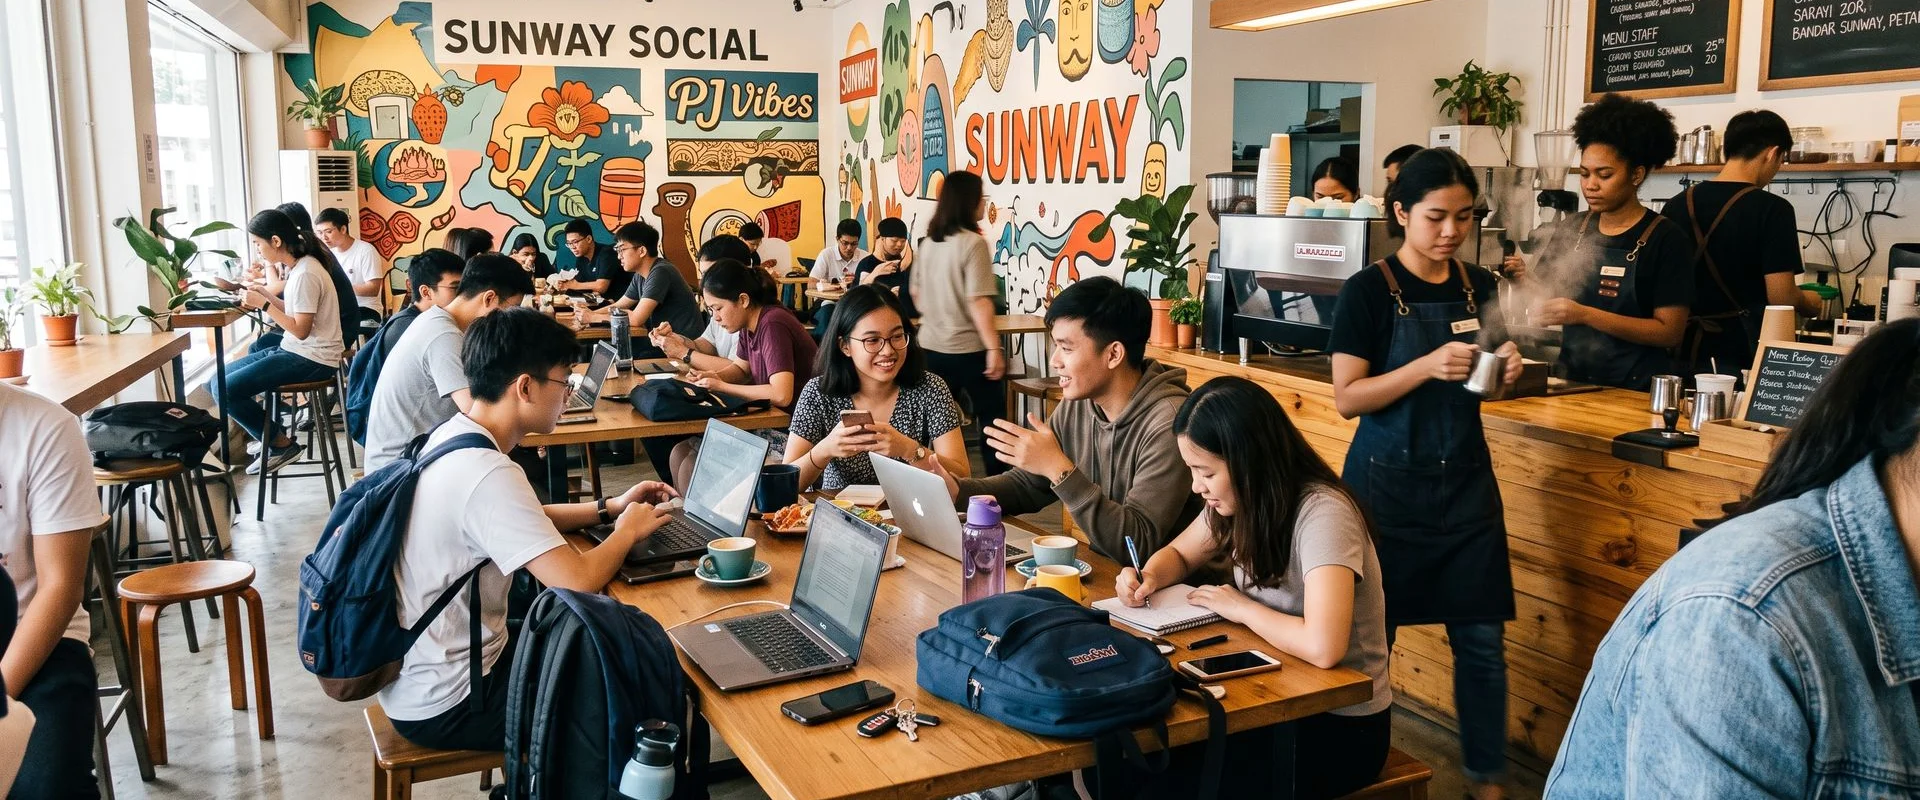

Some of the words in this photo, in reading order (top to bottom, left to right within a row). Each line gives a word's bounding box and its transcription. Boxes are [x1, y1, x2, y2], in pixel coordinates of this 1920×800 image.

[1792, 22, 1836, 40] BANDAR
[1840, 16, 1886, 34] SUNWAY,
[1794, 5, 1833, 22] SARAYI
[444, 19, 616, 57] SUNWAY
[629, 25, 769, 61] SOCIAL
[1602, 31, 1629, 46] MENU
[1631, 27, 1659, 42] STAFF
[1705, 54, 1717, 64] 20
[841, 58, 875, 95] SUNWAY
[667, 76, 726, 132] PJ
[731, 82, 815, 120] Vibes
[965, 94, 1140, 185] SUNWAY
